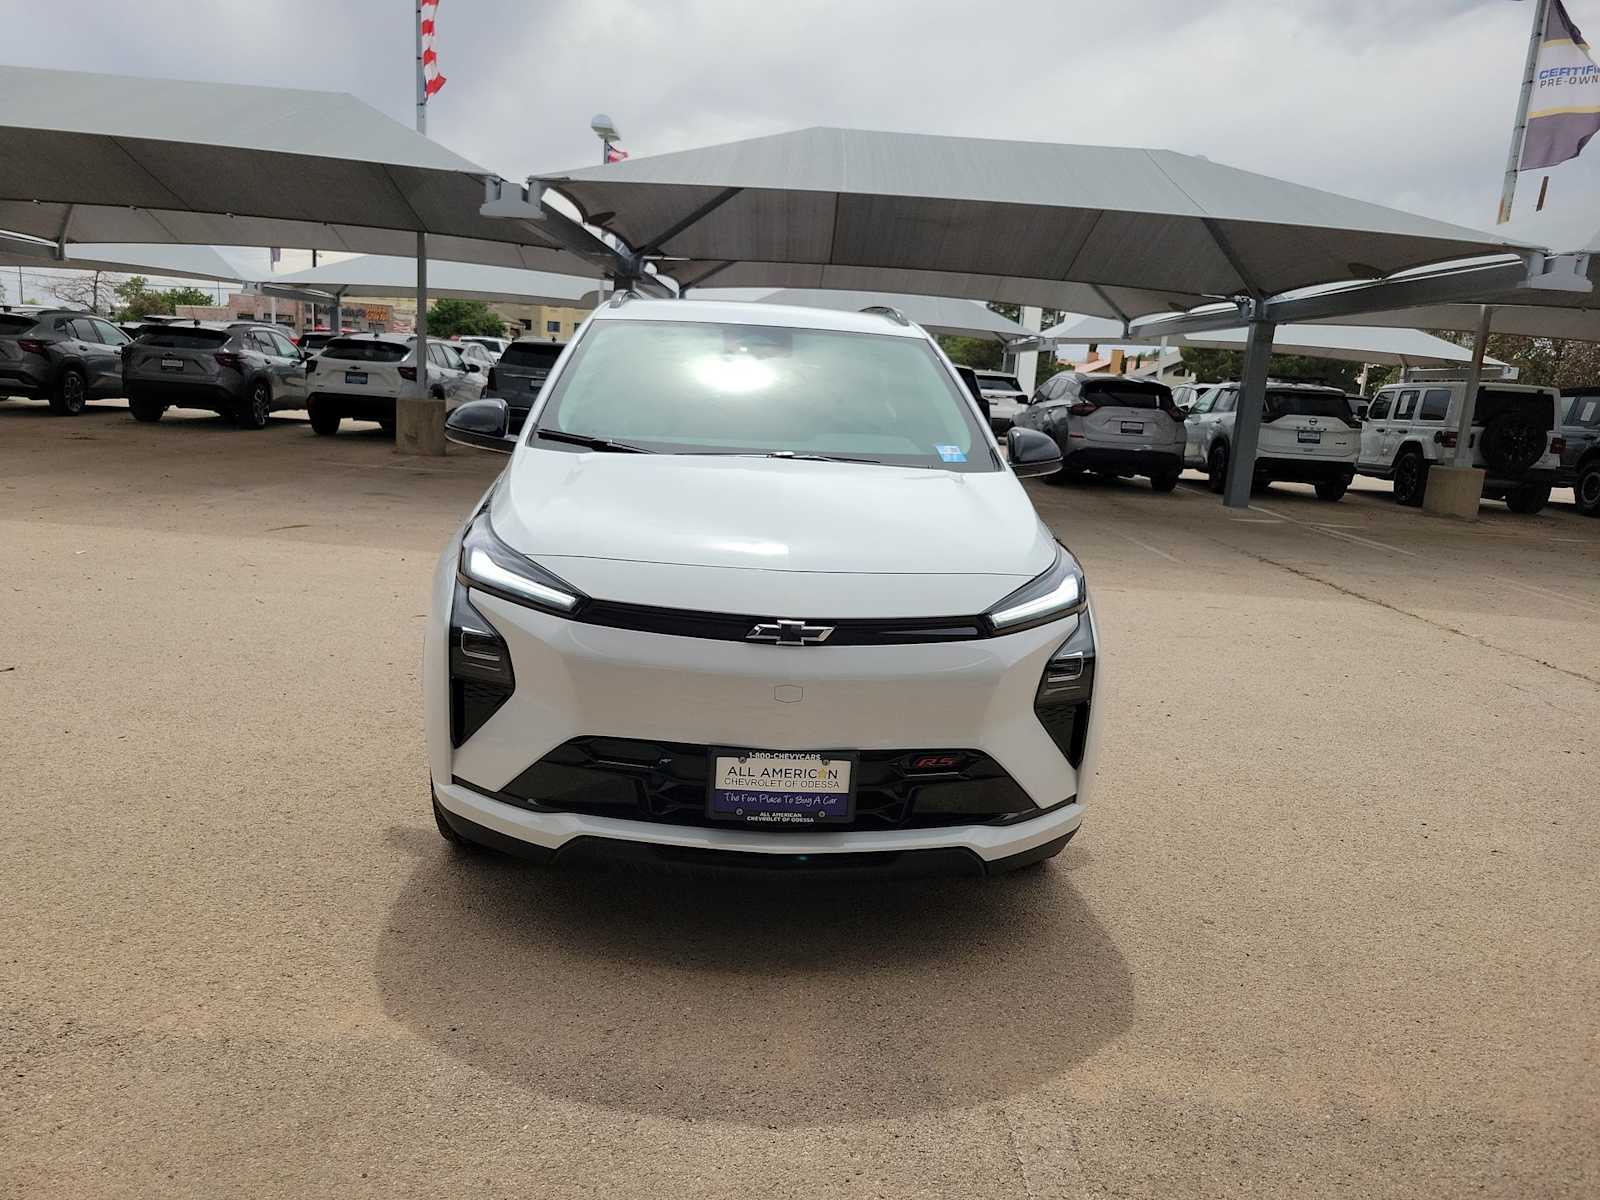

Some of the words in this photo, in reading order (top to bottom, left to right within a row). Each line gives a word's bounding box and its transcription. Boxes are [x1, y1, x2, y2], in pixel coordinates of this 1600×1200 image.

[916, 756, 953, 769] RS
[727, 766, 756, 777] ALL
[724, 777, 783, 788] CHEVROLET
[784, 780, 799, 788] OF
[800, 780, 840, 789] ODESSA
[723, 792, 740, 802] The
[759, 793, 782, 804] Place
[783, 794, 794, 804] To
[813, 795, 822, 806] A
[822, 795, 838, 806] Car
